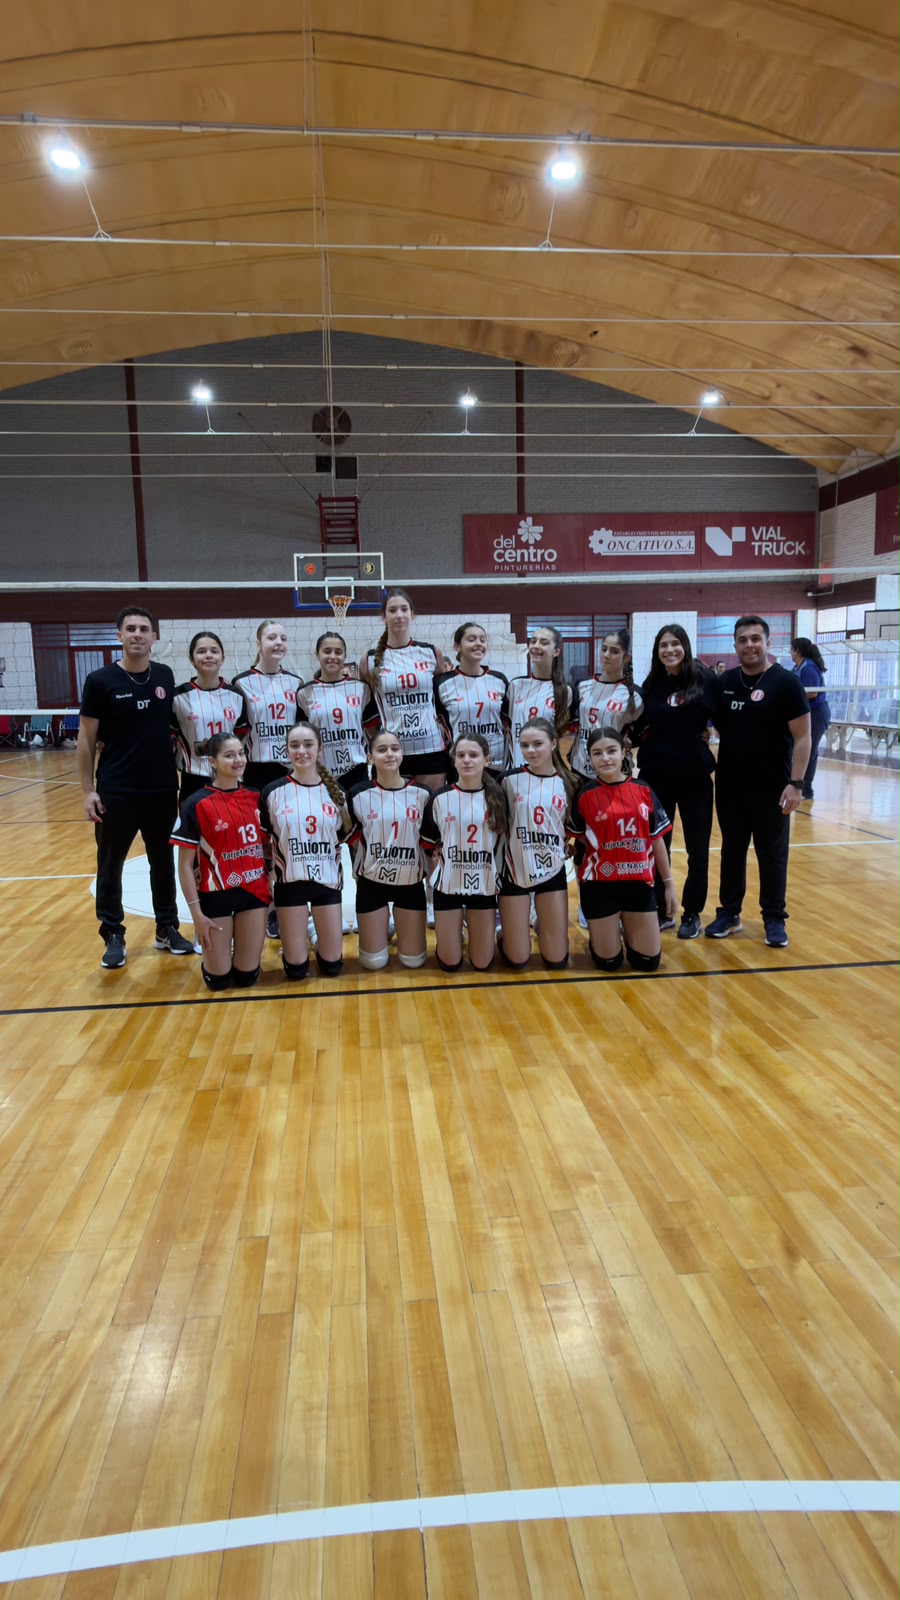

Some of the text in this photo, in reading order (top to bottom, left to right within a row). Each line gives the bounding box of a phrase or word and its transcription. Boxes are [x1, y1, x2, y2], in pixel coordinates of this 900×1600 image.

[752, 526, 786, 540] VIAL
[493, 535, 516, 549] del
[607, 539, 695, 551] ONCATIVO S.A.
[751, 541, 806, 556] TRUCK
[493, 546, 558, 563] centro
[398, 673, 418, 689] 10
[137, 699, 151, 710] DT
[268, 703, 286, 720] 12
[474, 702, 484, 718] 7
[731, 700, 745, 711] DT
[332, 707, 343, 725] 9
[589, 707, 599, 724] 5
[207, 721, 222, 736] 11
[397, 728, 428, 739] MAGGI
[533, 806, 545, 826] 6
[305, 815, 317, 835] 3
[391, 821, 399, 840] 1
[617, 817, 637, 836] 14
[238, 823, 258, 845] 13
[466, 824, 478, 843] 2
